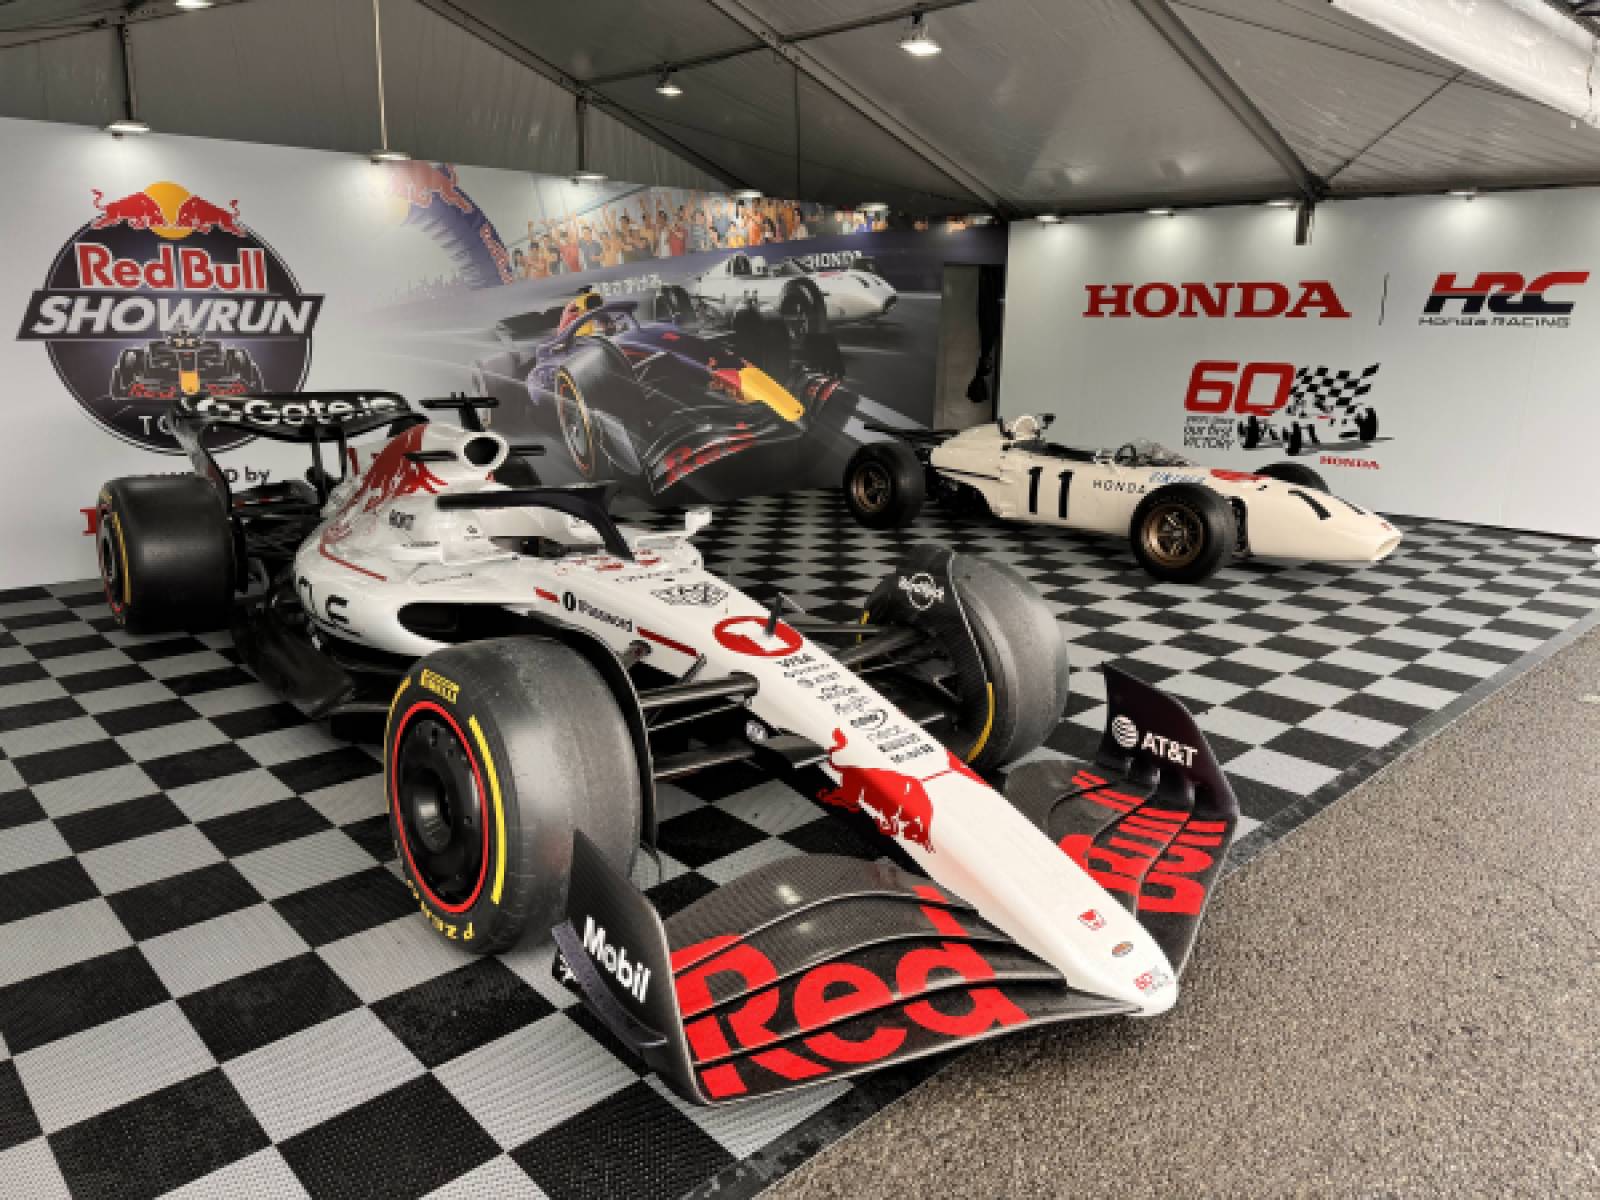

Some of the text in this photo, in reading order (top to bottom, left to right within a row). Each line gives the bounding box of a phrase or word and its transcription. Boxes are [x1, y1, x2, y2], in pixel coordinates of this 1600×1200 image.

[76, 242, 267, 292] Red Bull
[1083, 281, 1352, 318] HONDA
[1423, 271, 1590, 315] HRC
[31, 295, 314, 334] SHOWRUN
[1418, 317, 1571, 328] Honda RACING
[1184, 360, 1297, 416] 60
[245, 466, 270, 485] by
[1320, 455, 1380, 470] HONDA
[1028, 466, 1075, 520] 11
[1093, 479, 1145, 494] HONDA
[420, 668, 460, 704] PIRELLI
[1141, 732, 1198, 768] AT&T
[584, 914, 652, 1004] Mobil
[671, 885, 1029, 1099] Red
